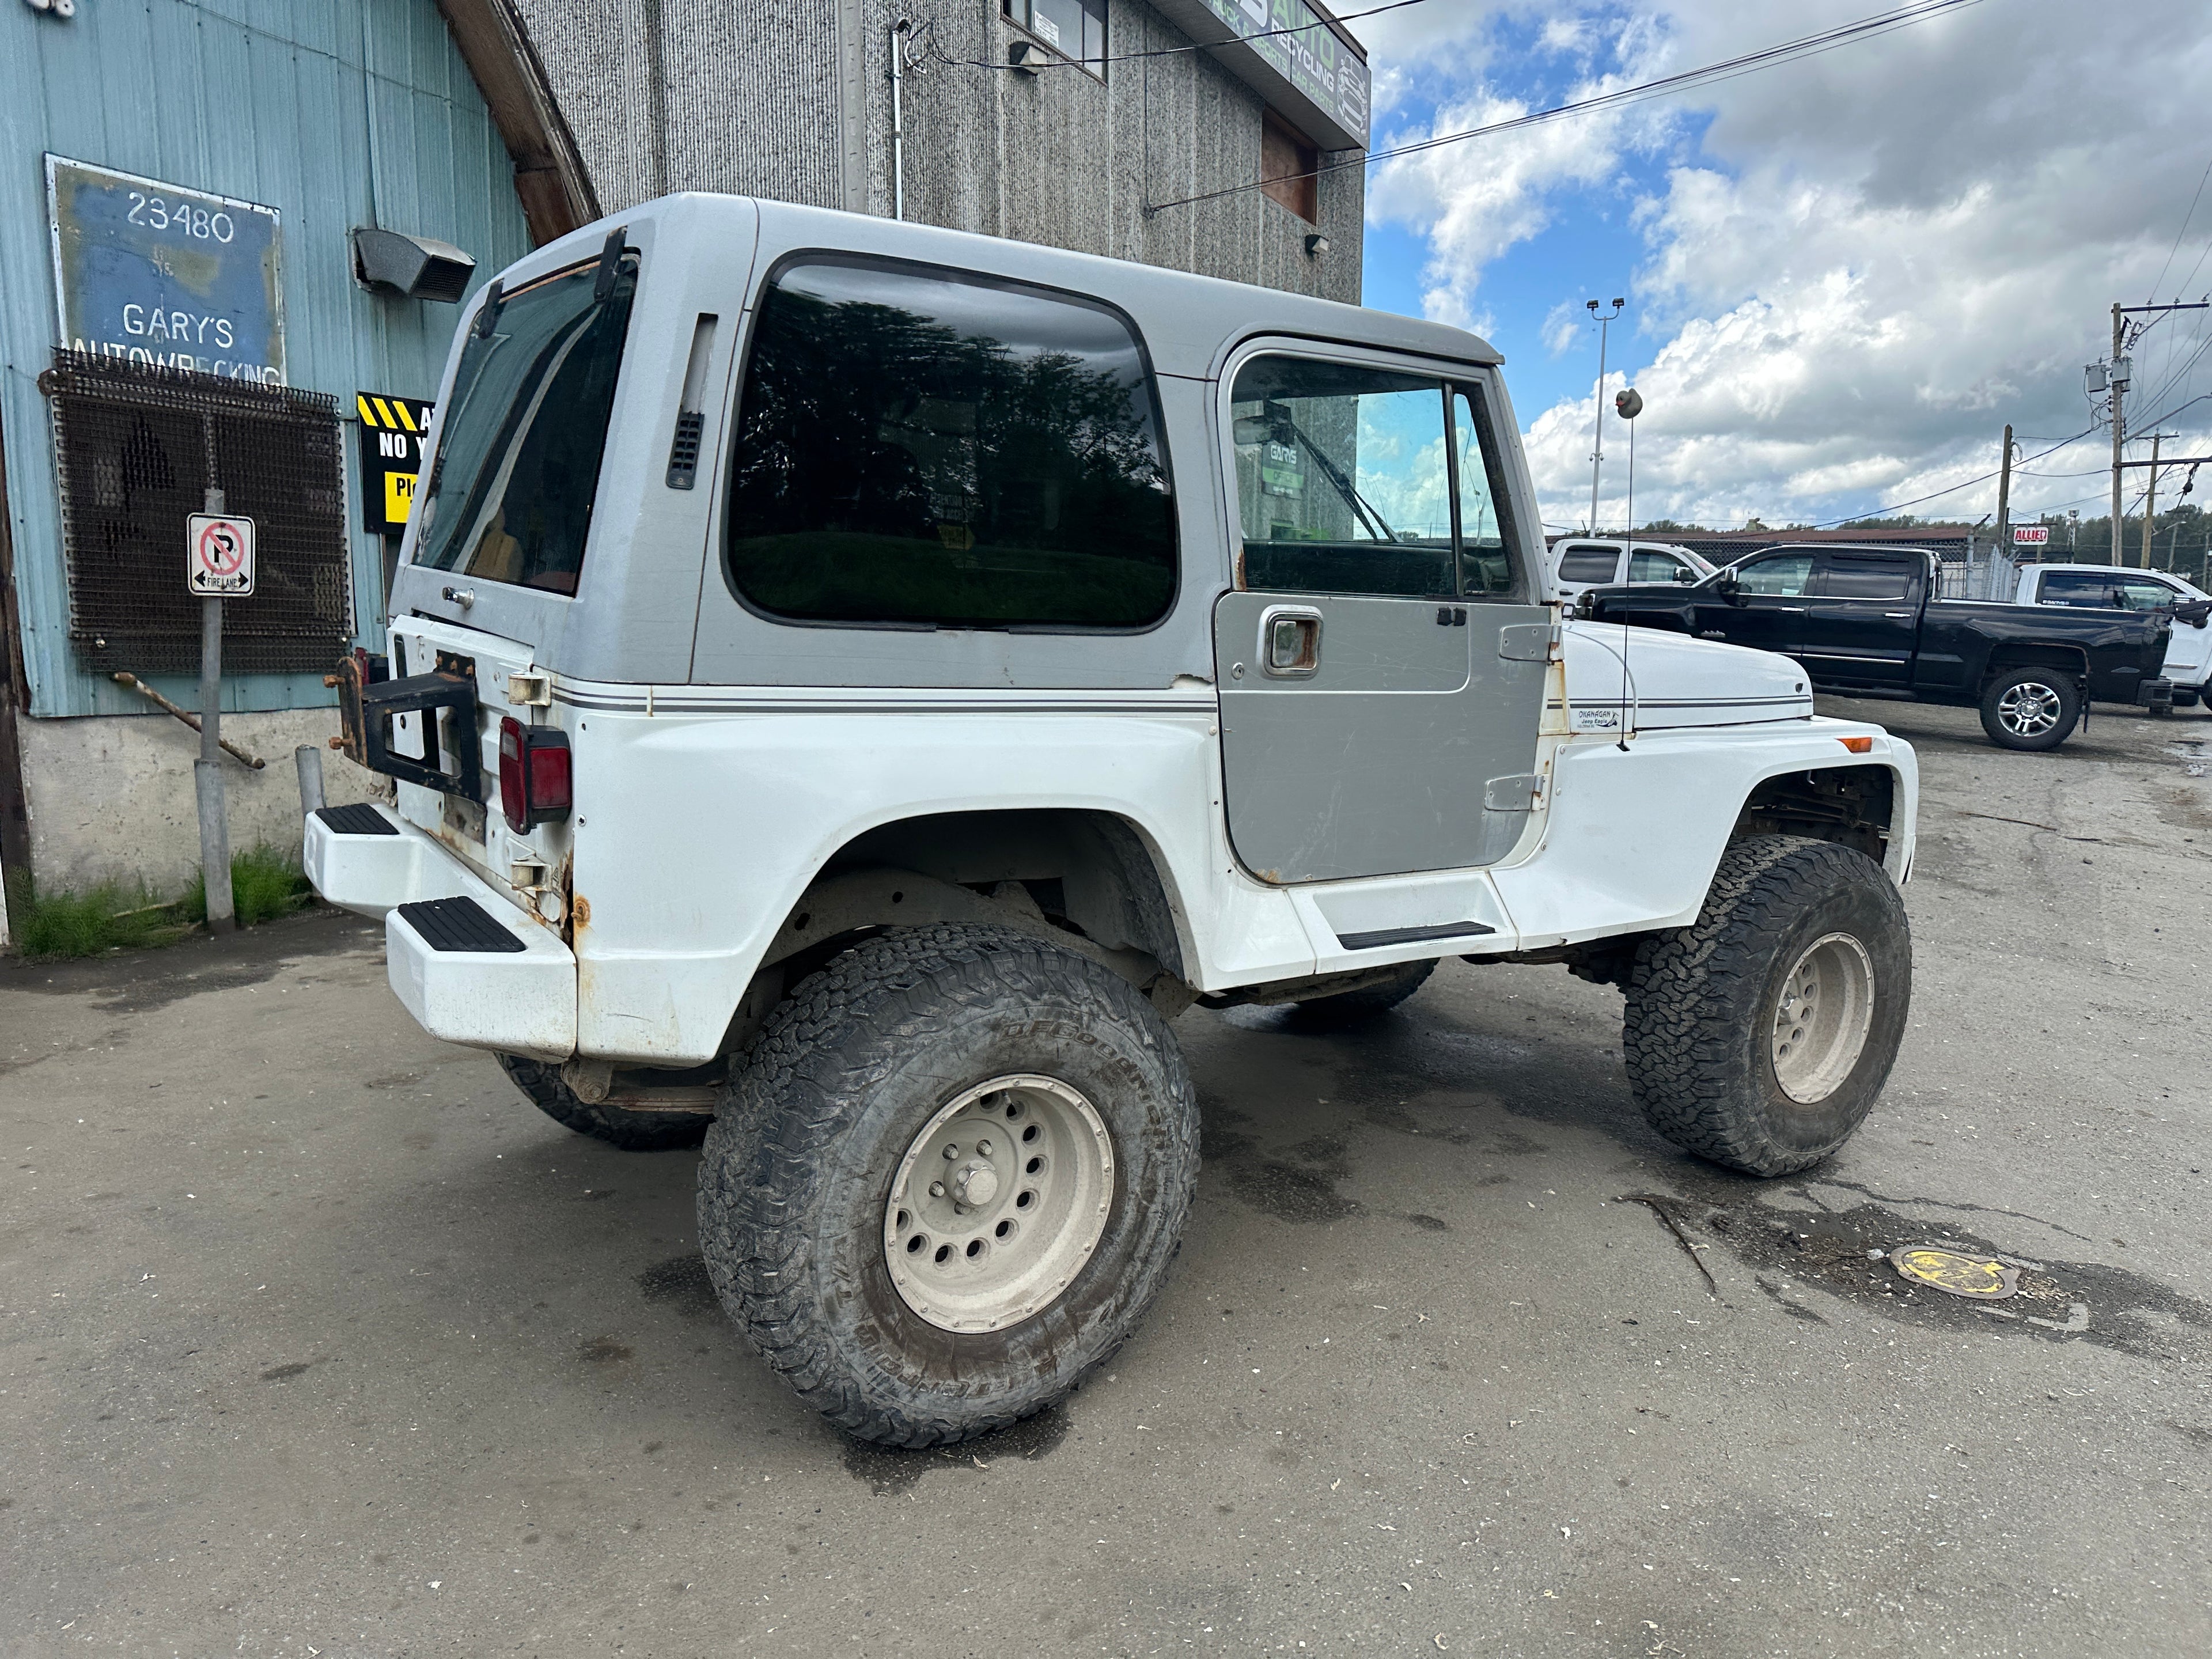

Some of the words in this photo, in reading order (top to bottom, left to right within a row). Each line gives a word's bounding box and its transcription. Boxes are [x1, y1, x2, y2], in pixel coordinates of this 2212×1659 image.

[1253, 30, 1287, 71] SPORTS
[1291, 65, 1308, 90] CAR
[1309, 81, 1334, 113] PARTS
[1271, 17, 1334, 93] RECYCLING
[127, 191, 234, 243] 23480
[123, 303, 233, 349] GARY'S
[379, 432, 407, 459] NO
[2016, 530, 2047, 540] ALLIED
[207, 577, 220, 587] FIRE
[222, 578, 238, 588] LANE
[1579, 710, 1611, 718] OKANAGAN
